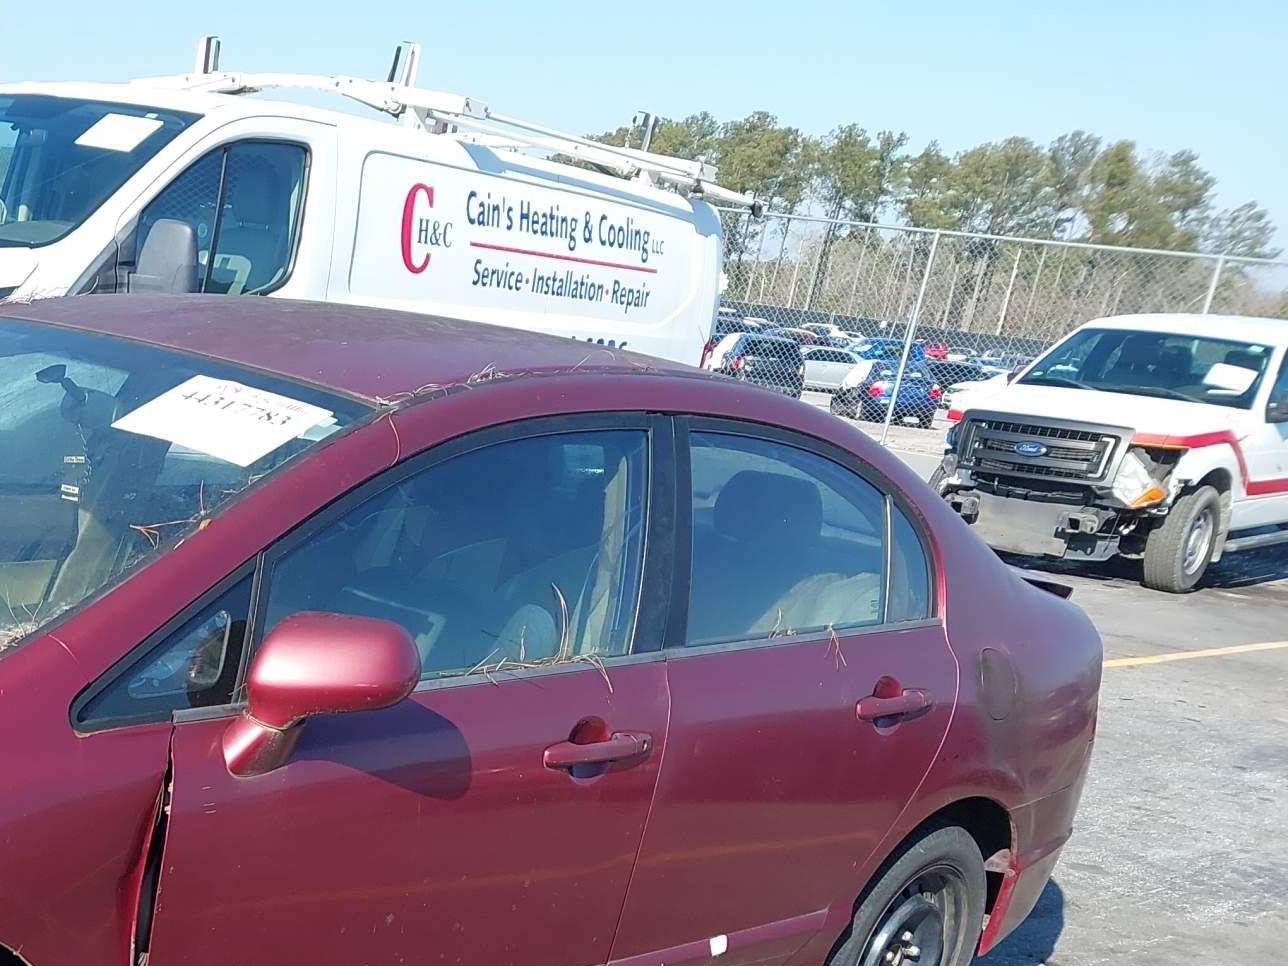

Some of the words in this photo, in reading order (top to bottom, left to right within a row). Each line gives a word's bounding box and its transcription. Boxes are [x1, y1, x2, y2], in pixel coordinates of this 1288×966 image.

[401, 183, 434, 274] C
[466, 191, 514, 231] Cain's
[519, 200, 578, 251] Heating
[583, 211, 593, 243] &
[598, 214, 650, 263] Cooling
[472, 259, 523, 292] Service
[531, 268, 604, 302] Installation
[611, 280, 651, 314] Repair
